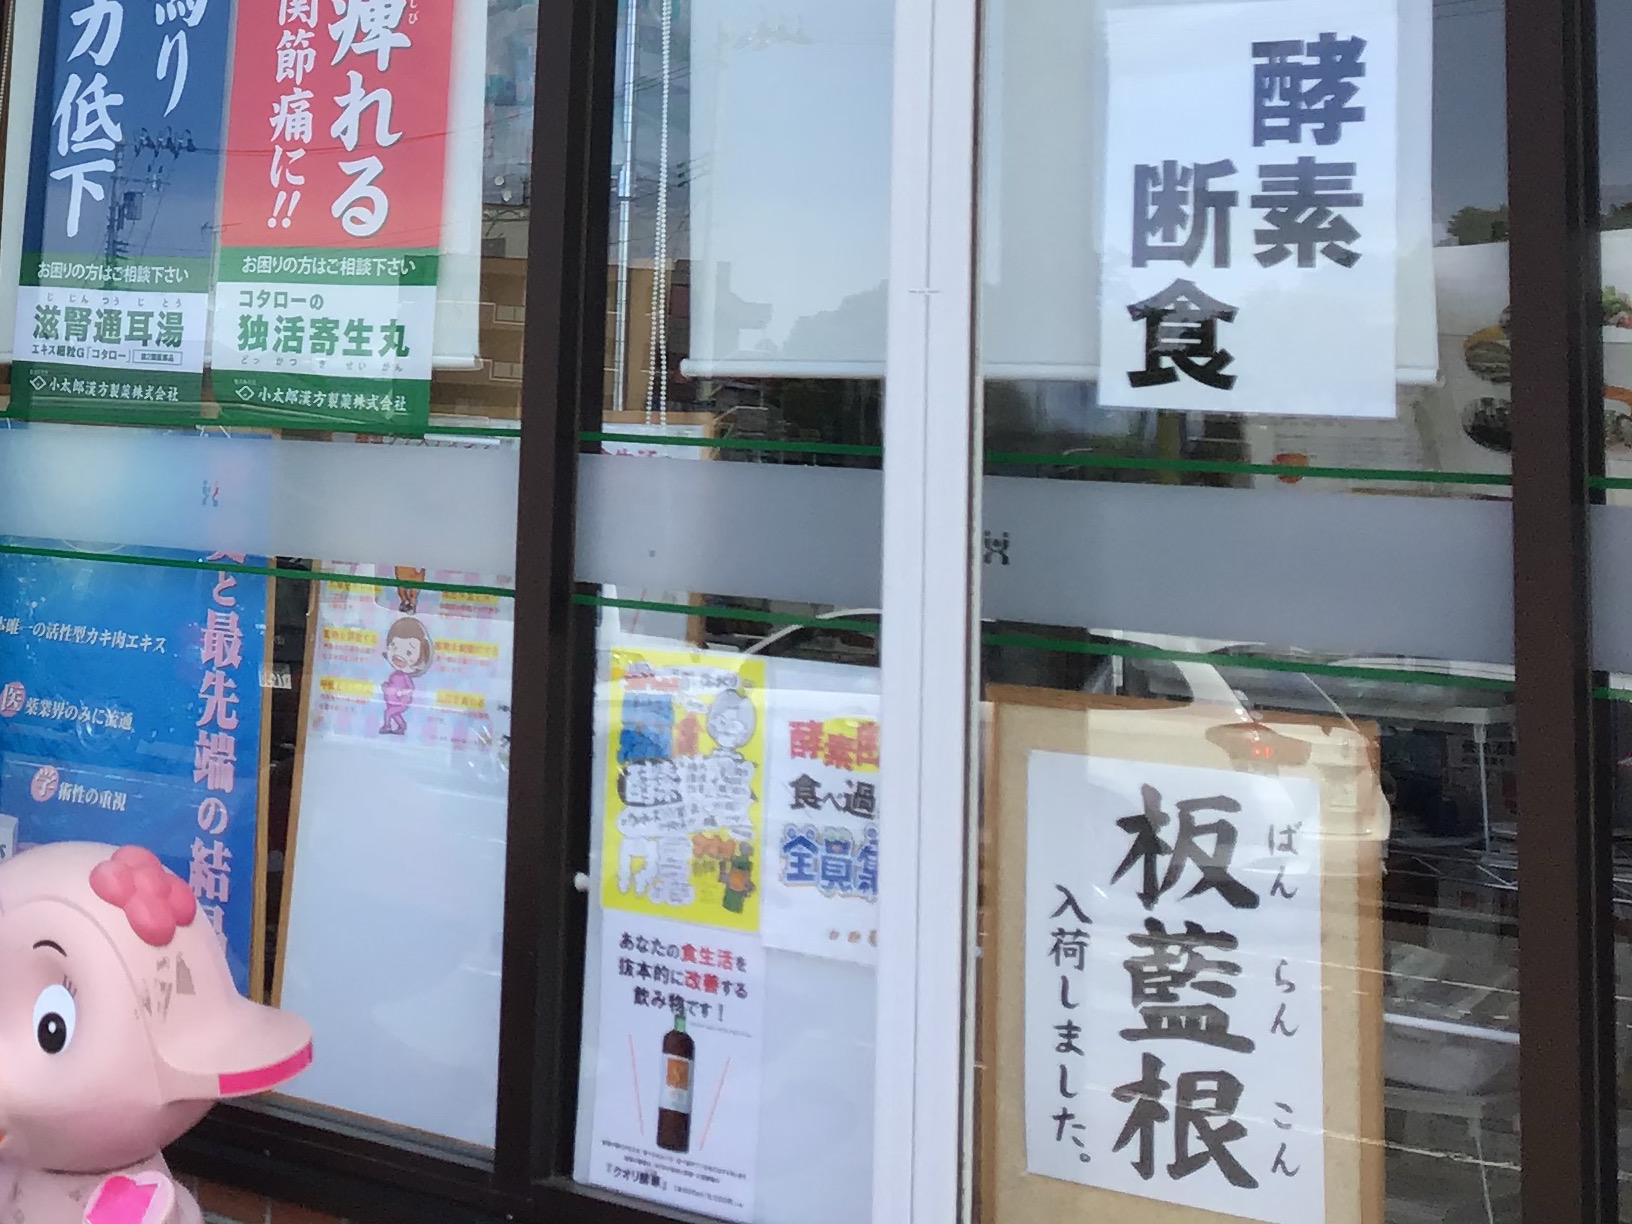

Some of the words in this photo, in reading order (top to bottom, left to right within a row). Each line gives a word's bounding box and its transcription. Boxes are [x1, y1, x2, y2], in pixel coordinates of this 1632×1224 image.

[1251, 32, 1366, 268] 酵素
[37, 262, 190, 284] お困りの方はご相談下さい
[242, 256, 416, 277] お困りの方はご相談下さい
[1126, 158, 1239, 390] 断食
[239, 289, 324, 310] コタローの
[33, 304, 184, 348] 滋腎通耳湯
[237, 314, 410, 358] 独活寄生丸
[50, 376, 179, 402] 小太郎漢方製薬株式会社
[257, 386, 407, 412] 小太郎漢方製薬株式会社
[1, 683, 134, 731] 医薬業界のみに流通
[189, 550, 247, 956] と最先端の結
[35, 767, 127, 812] 学術性の重視
[619, 932, 747, 974] あなたの食生活を
[1110, 783, 1259, 1189] 板藍根
